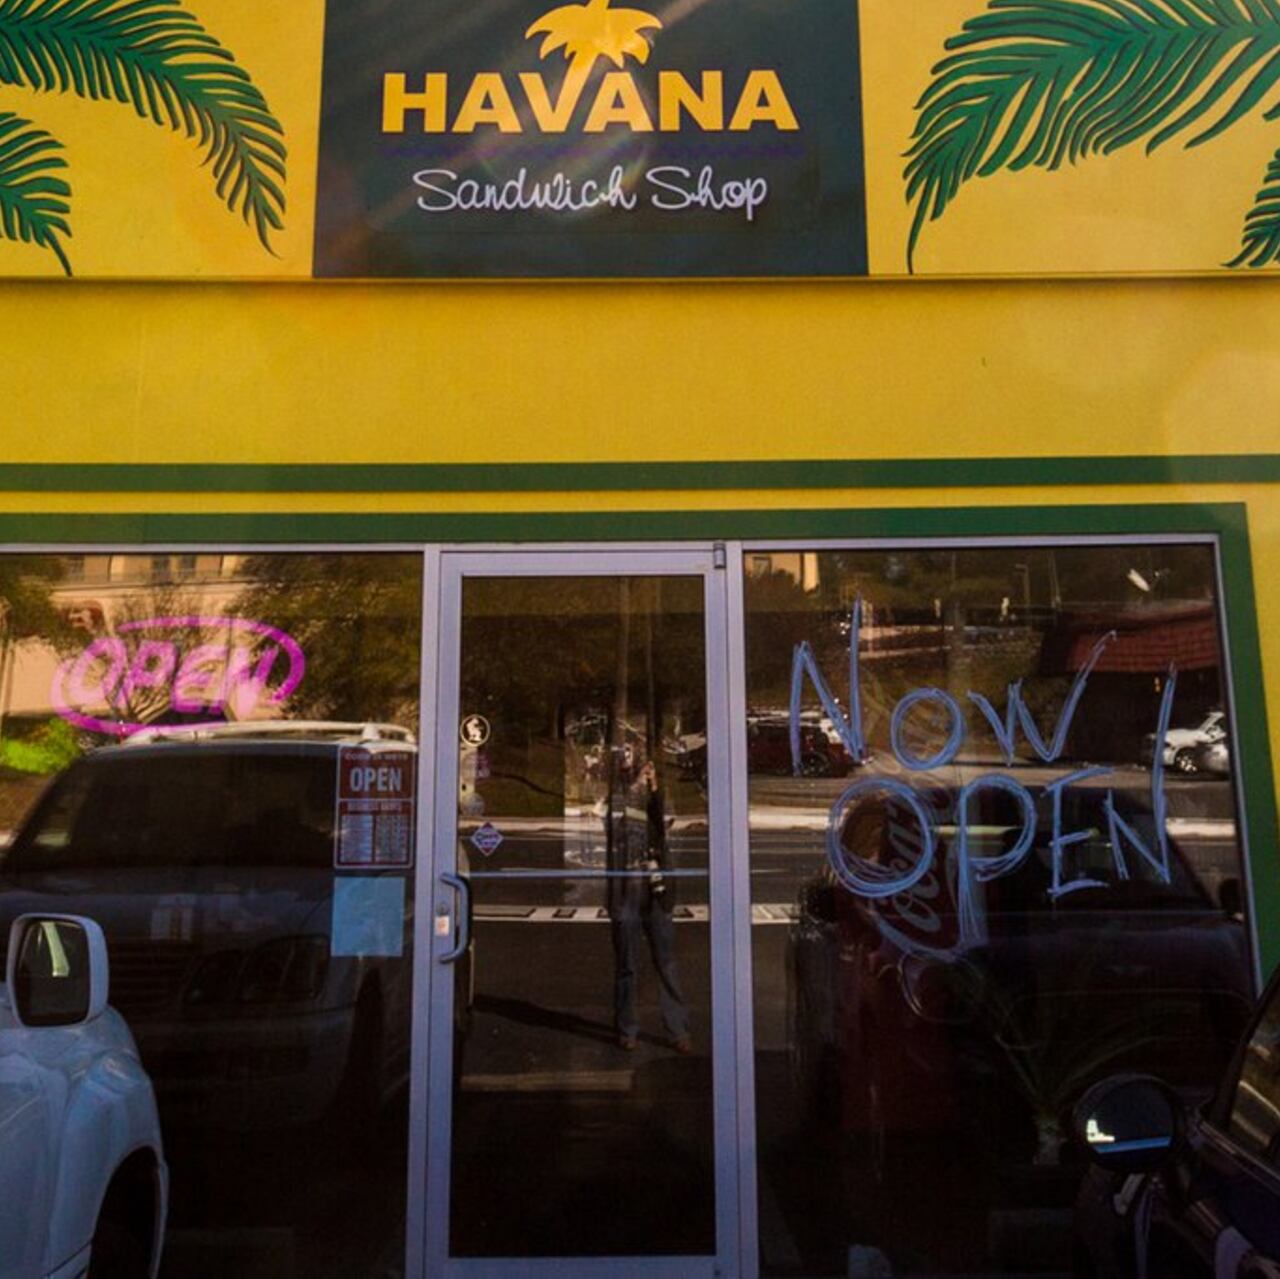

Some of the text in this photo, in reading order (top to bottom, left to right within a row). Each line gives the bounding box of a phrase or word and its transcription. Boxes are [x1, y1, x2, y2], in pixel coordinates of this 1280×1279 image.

[381, 69, 800, 133] HAVANA
[412, 166, 768, 221] Sandwich Shop
[63, 634, 276, 717] OPEN
[350, 766, 402, 792] OPEN
[826, 661, 1178, 948] OPEN
